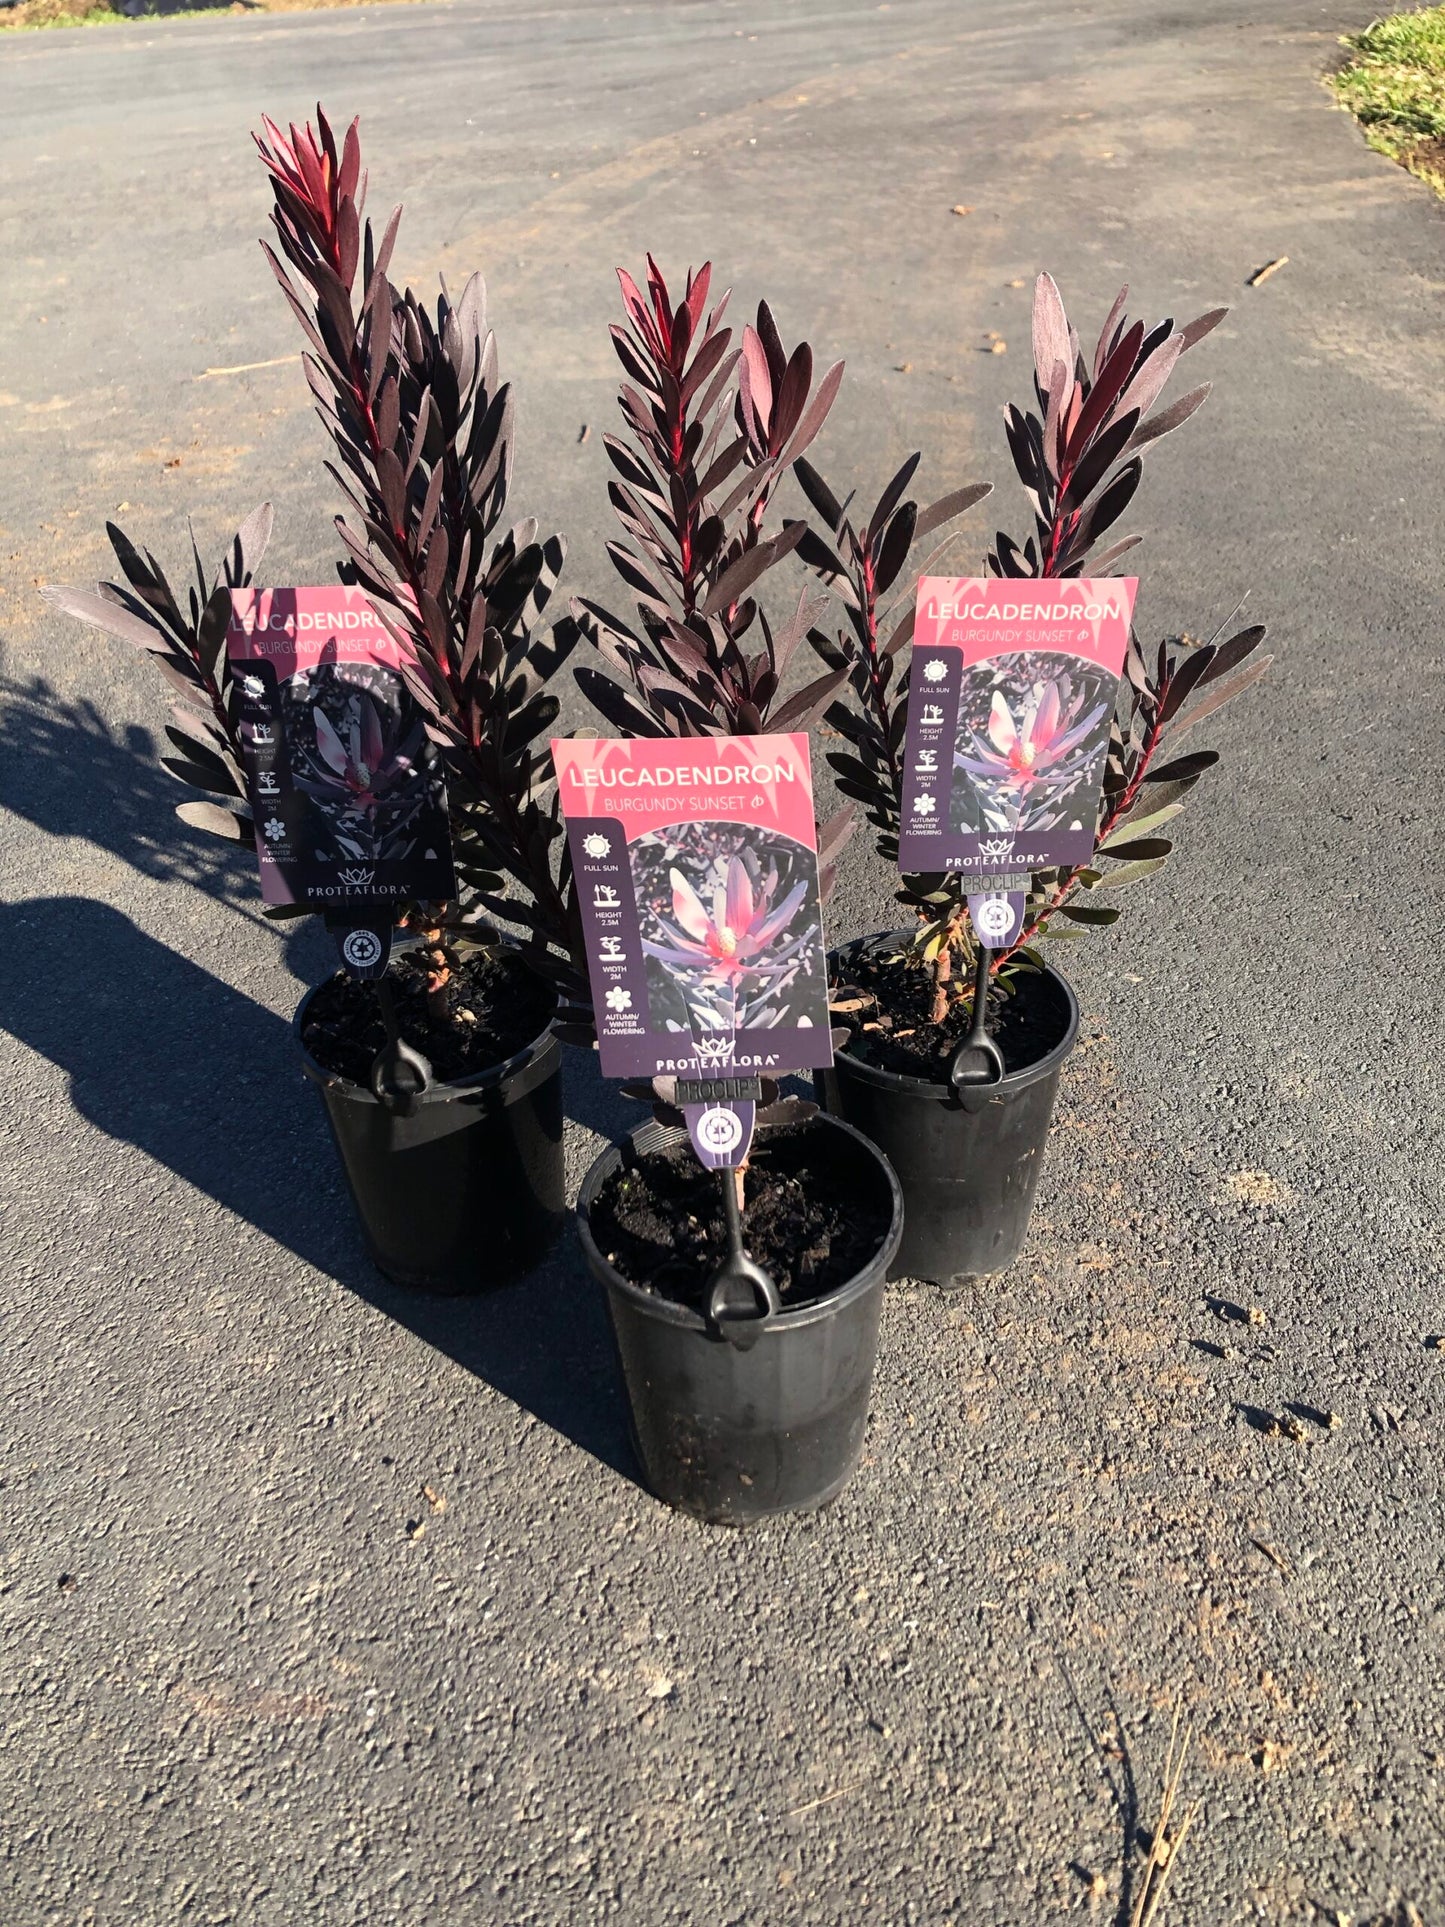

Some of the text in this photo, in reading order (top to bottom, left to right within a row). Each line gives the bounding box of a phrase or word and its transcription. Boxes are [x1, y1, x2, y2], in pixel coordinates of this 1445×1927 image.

[927, 602, 1121, 621] LEUCADENDRON
[231, 610, 398, 632] LEUCADENDR
[951, 629, 1074, 642] BURGUNDY SUNSET
[259, 638, 371, 655] BURGUNDY SUNSET
[568, 763, 795, 788] LEUCADENDRON
[604, 795, 746, 812] BURGUNDY SUNSET
[584, 864, 619, 872] FULL SUN
[602, 965, 627, 973] WIDTH
[603, 1027, 646, 1035] FLOWERING
[609, 1020, 637, 1028] WINTER
